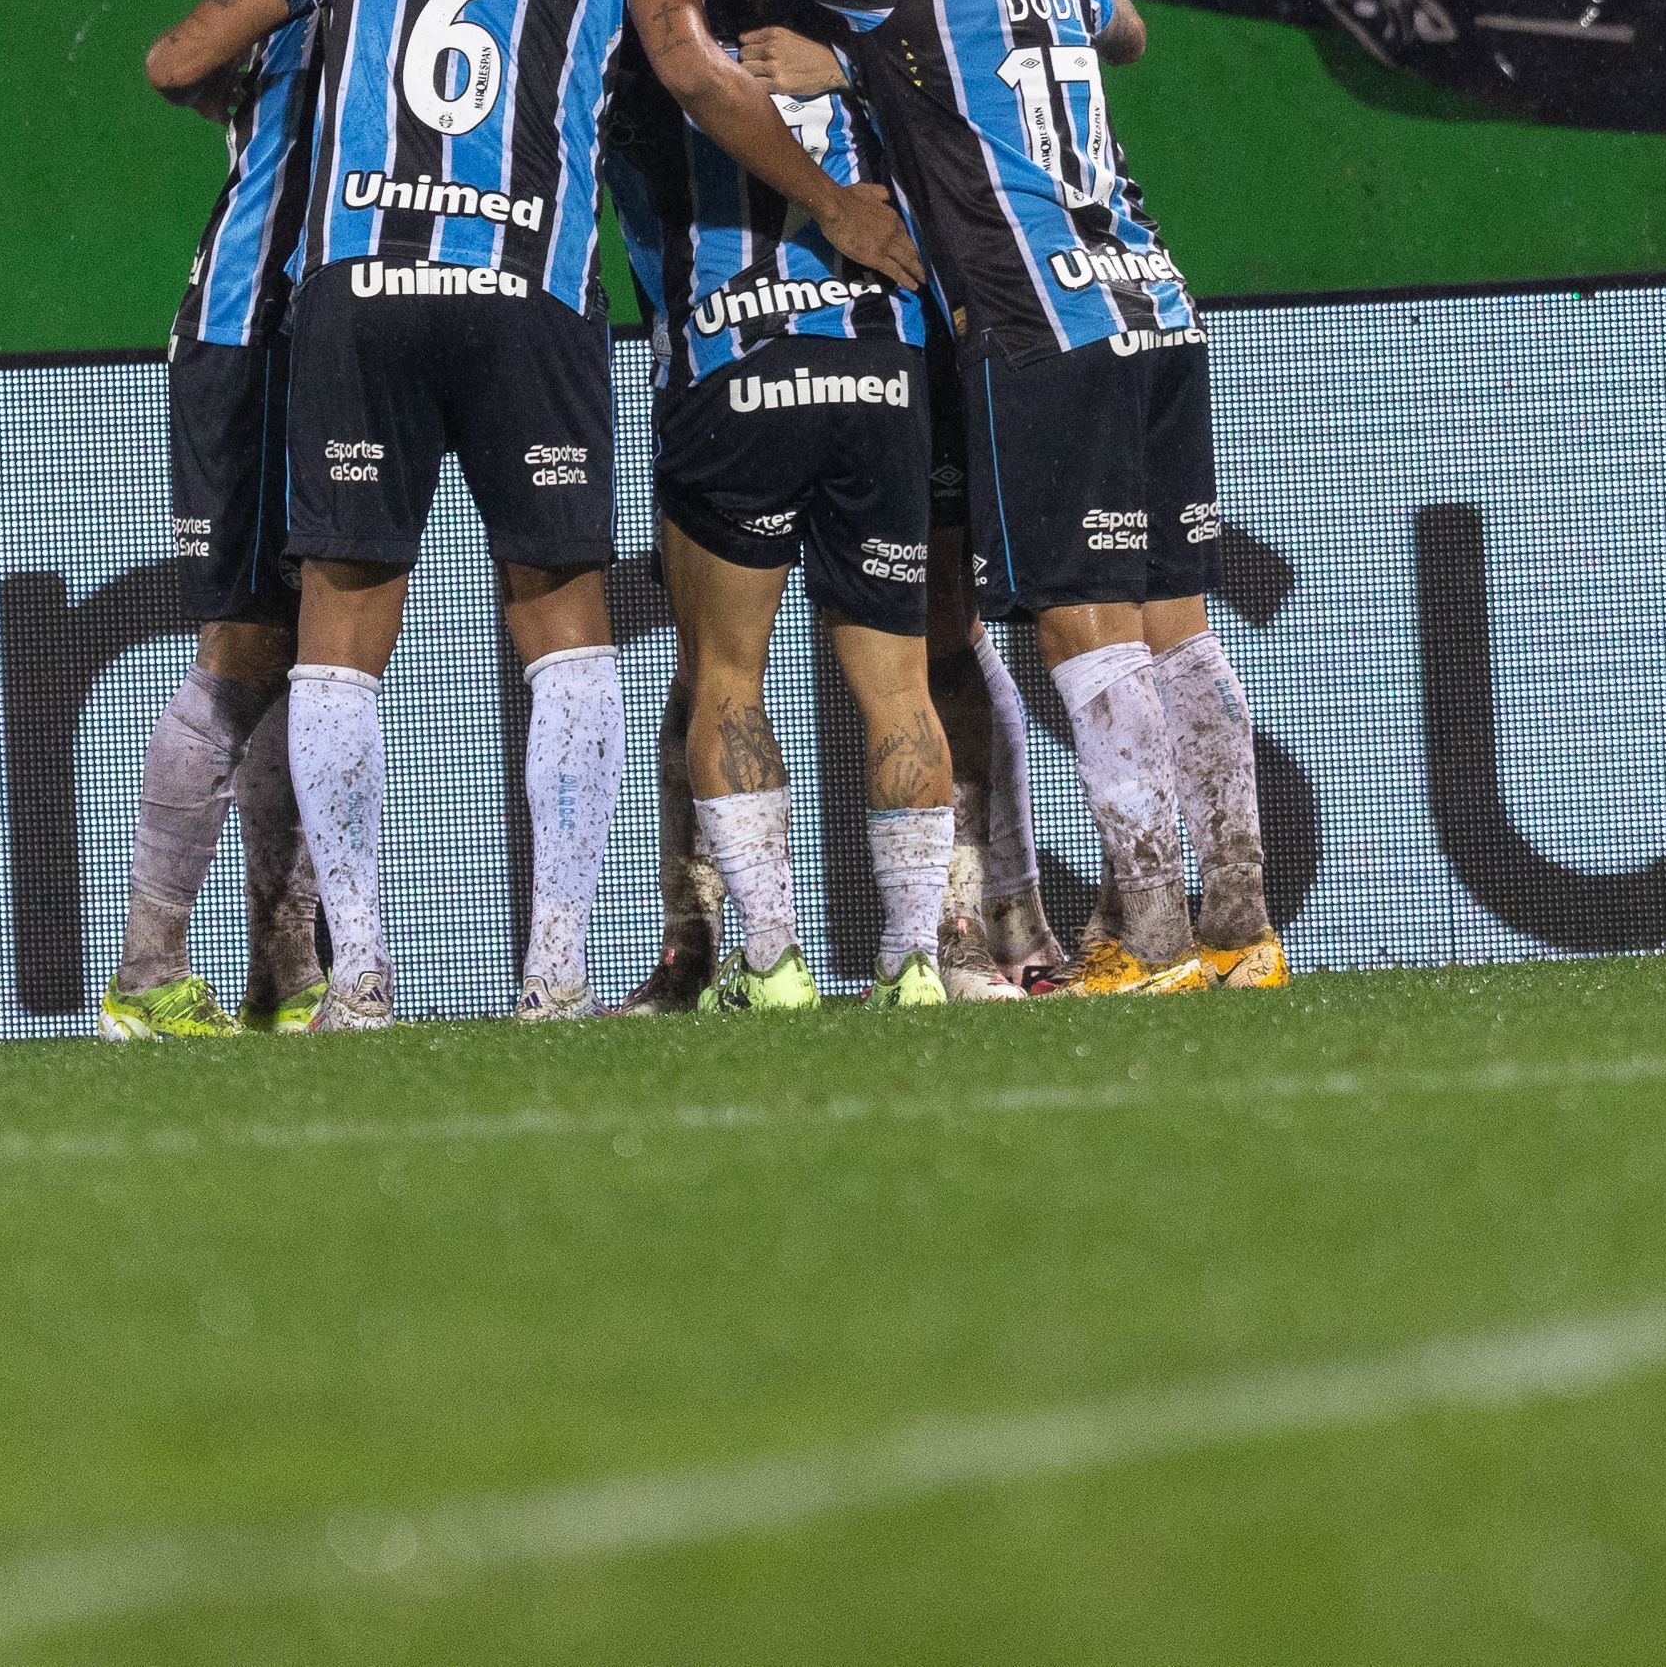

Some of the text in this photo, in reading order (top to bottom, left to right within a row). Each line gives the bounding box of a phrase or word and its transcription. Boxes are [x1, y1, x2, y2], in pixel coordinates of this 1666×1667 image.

[474, 46, 492, 110] MARQUESPAN
[996, 46, 1115, 210] 17
[344, 174, 544, 232] Unimed
[729, 367, 910, 413] Unimed
[324, 439, 386, 462] Esportes
[524, 444, 589, 467] Esportes
